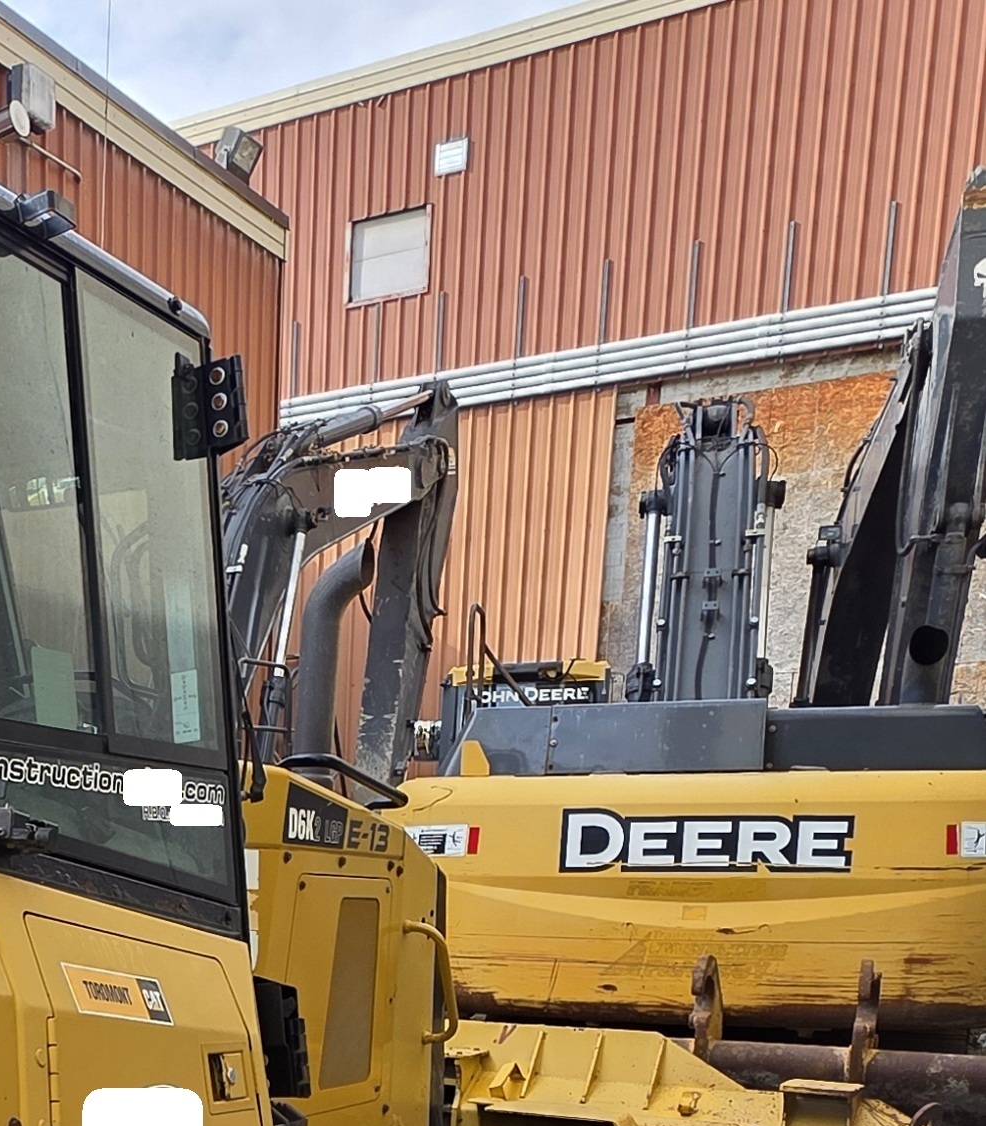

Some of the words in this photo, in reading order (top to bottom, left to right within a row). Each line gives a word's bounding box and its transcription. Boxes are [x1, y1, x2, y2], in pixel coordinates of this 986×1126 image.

[525, 686, 590, 702] DEERE
[347, 818, 390, 852] E-13
[564, 811, 851, 869] DEERE
[81, 980, 133, 1005] TOROMONT
[141, 988, 165, 1012] CAT
